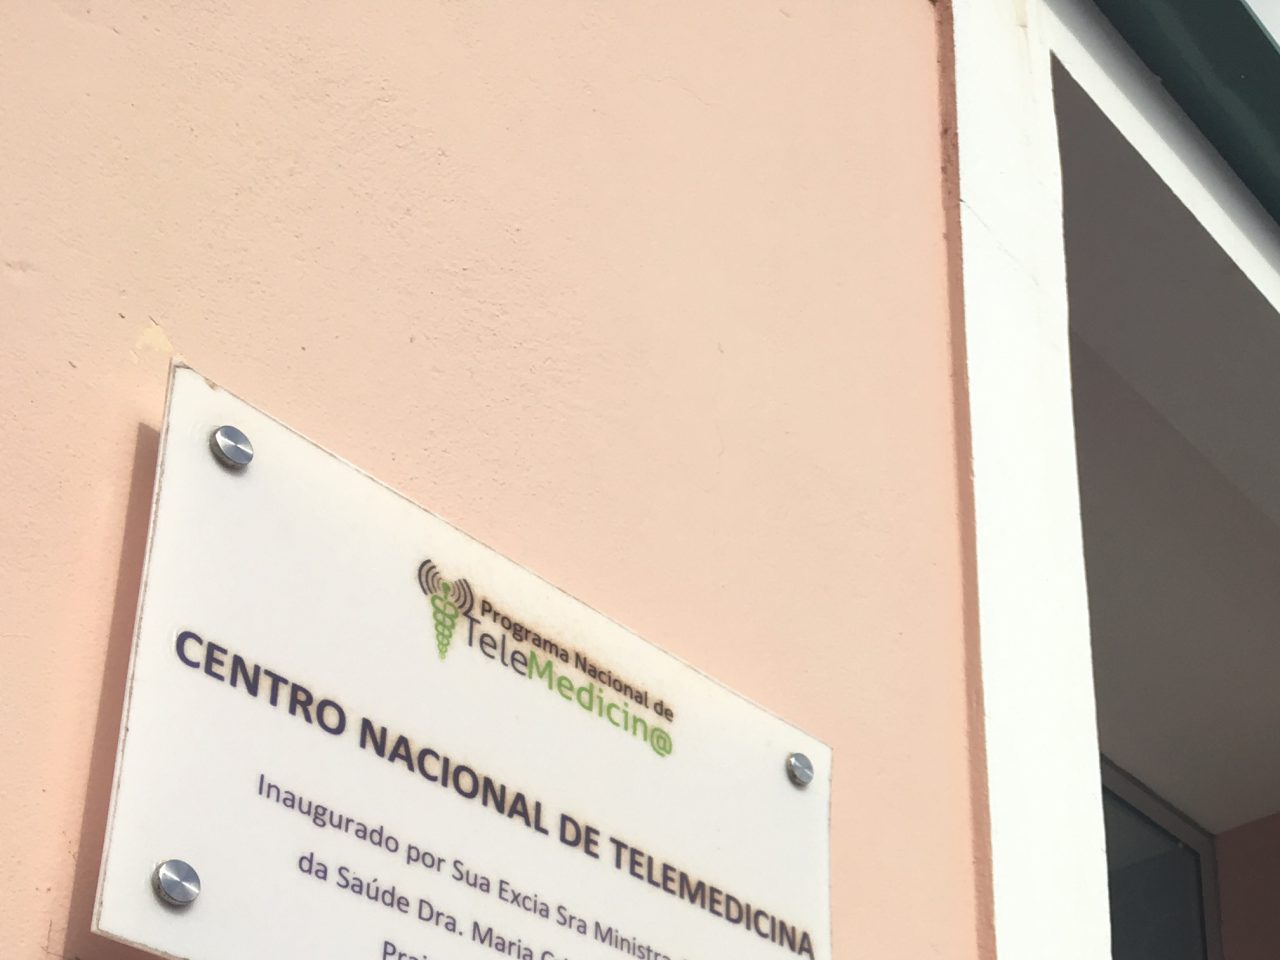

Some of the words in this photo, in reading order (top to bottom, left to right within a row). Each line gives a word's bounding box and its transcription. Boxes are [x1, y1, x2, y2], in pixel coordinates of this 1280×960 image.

[462, 612, 674, 758] TeleMedicin@
[479, 598, 570, 664] Programa
[574, 650, 650, 709] Nacional
[653, 699, 675, 723] de
[174, 629, 348, 737] CENTRO
[358, 716, 550, 837] NACIONAL
[557, 812, 601, 860] DE
[257, 773, 400, 854] Inaugurado
[406, 843, 447, 873] por
[451, 859, 491, 895] Sua
[497, 878, 551, 920] Excia
[555, 904, 588, 936] Sra
[297, 851, 329, 882] da
[335, 865, 411, 915] Saúde
[417, 898, 465, 937] Dra.
